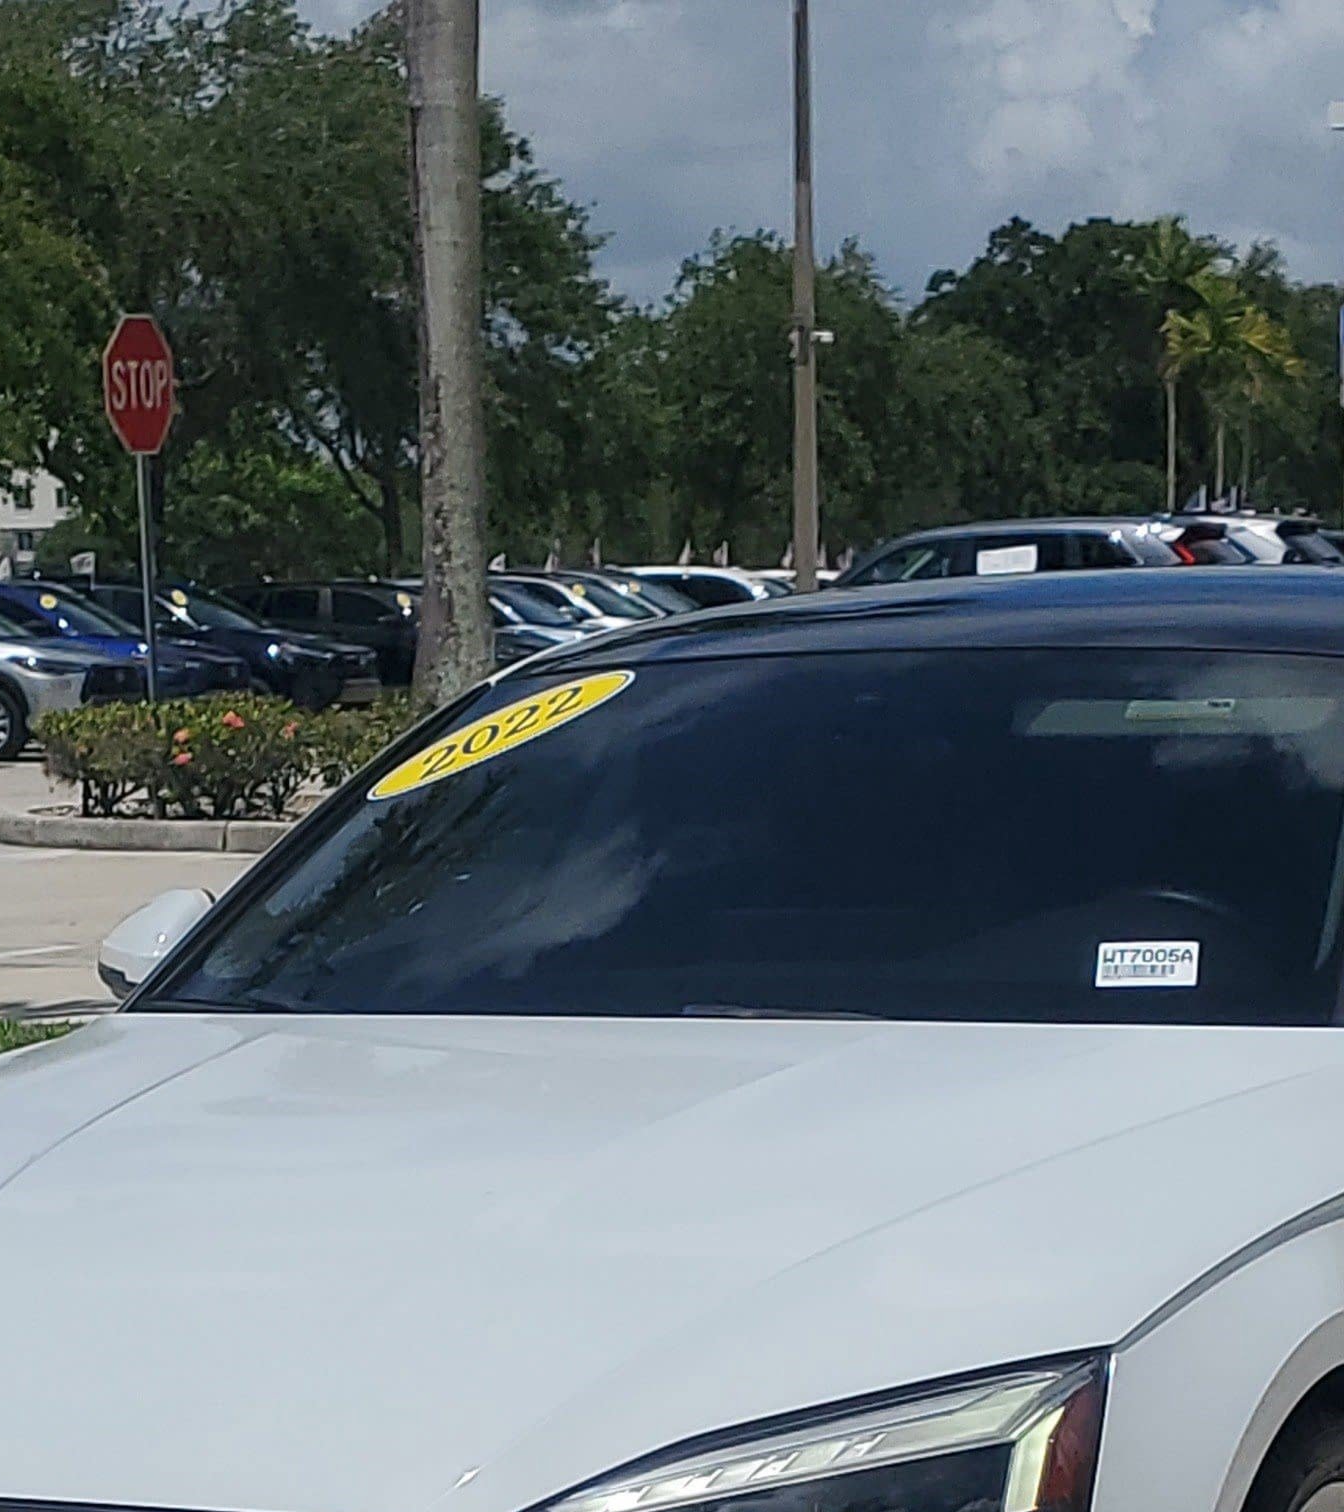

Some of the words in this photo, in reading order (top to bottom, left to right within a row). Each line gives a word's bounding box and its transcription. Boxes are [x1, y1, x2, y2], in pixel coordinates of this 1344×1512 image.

[111, 360, 168, 411] STOP
[420, 686, 585, 781] 2022
[1103, 948, 1193, 964] WT7005A
